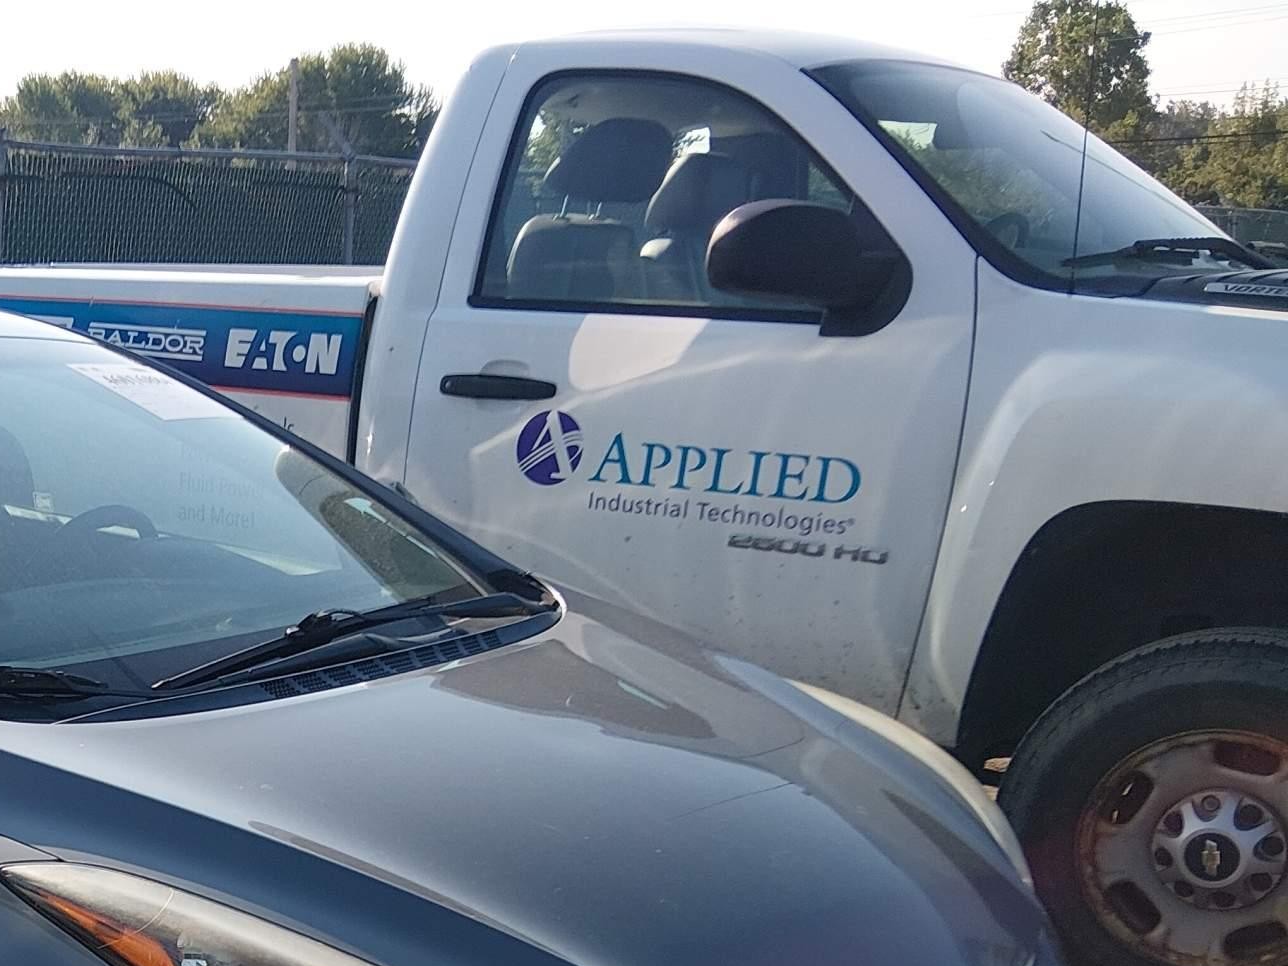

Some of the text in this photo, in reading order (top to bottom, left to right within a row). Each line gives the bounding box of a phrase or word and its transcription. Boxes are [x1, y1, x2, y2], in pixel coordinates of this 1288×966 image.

[1224, 284, 1288, 295] VORTE
[87, 327, 206, 355] BALDOR
[223, 327, 343, 375] EATON
[588, 430, 861, 504] APPLIED
[178, 503, 205, 522] and
[588, 491, 689, 520] Industrial
